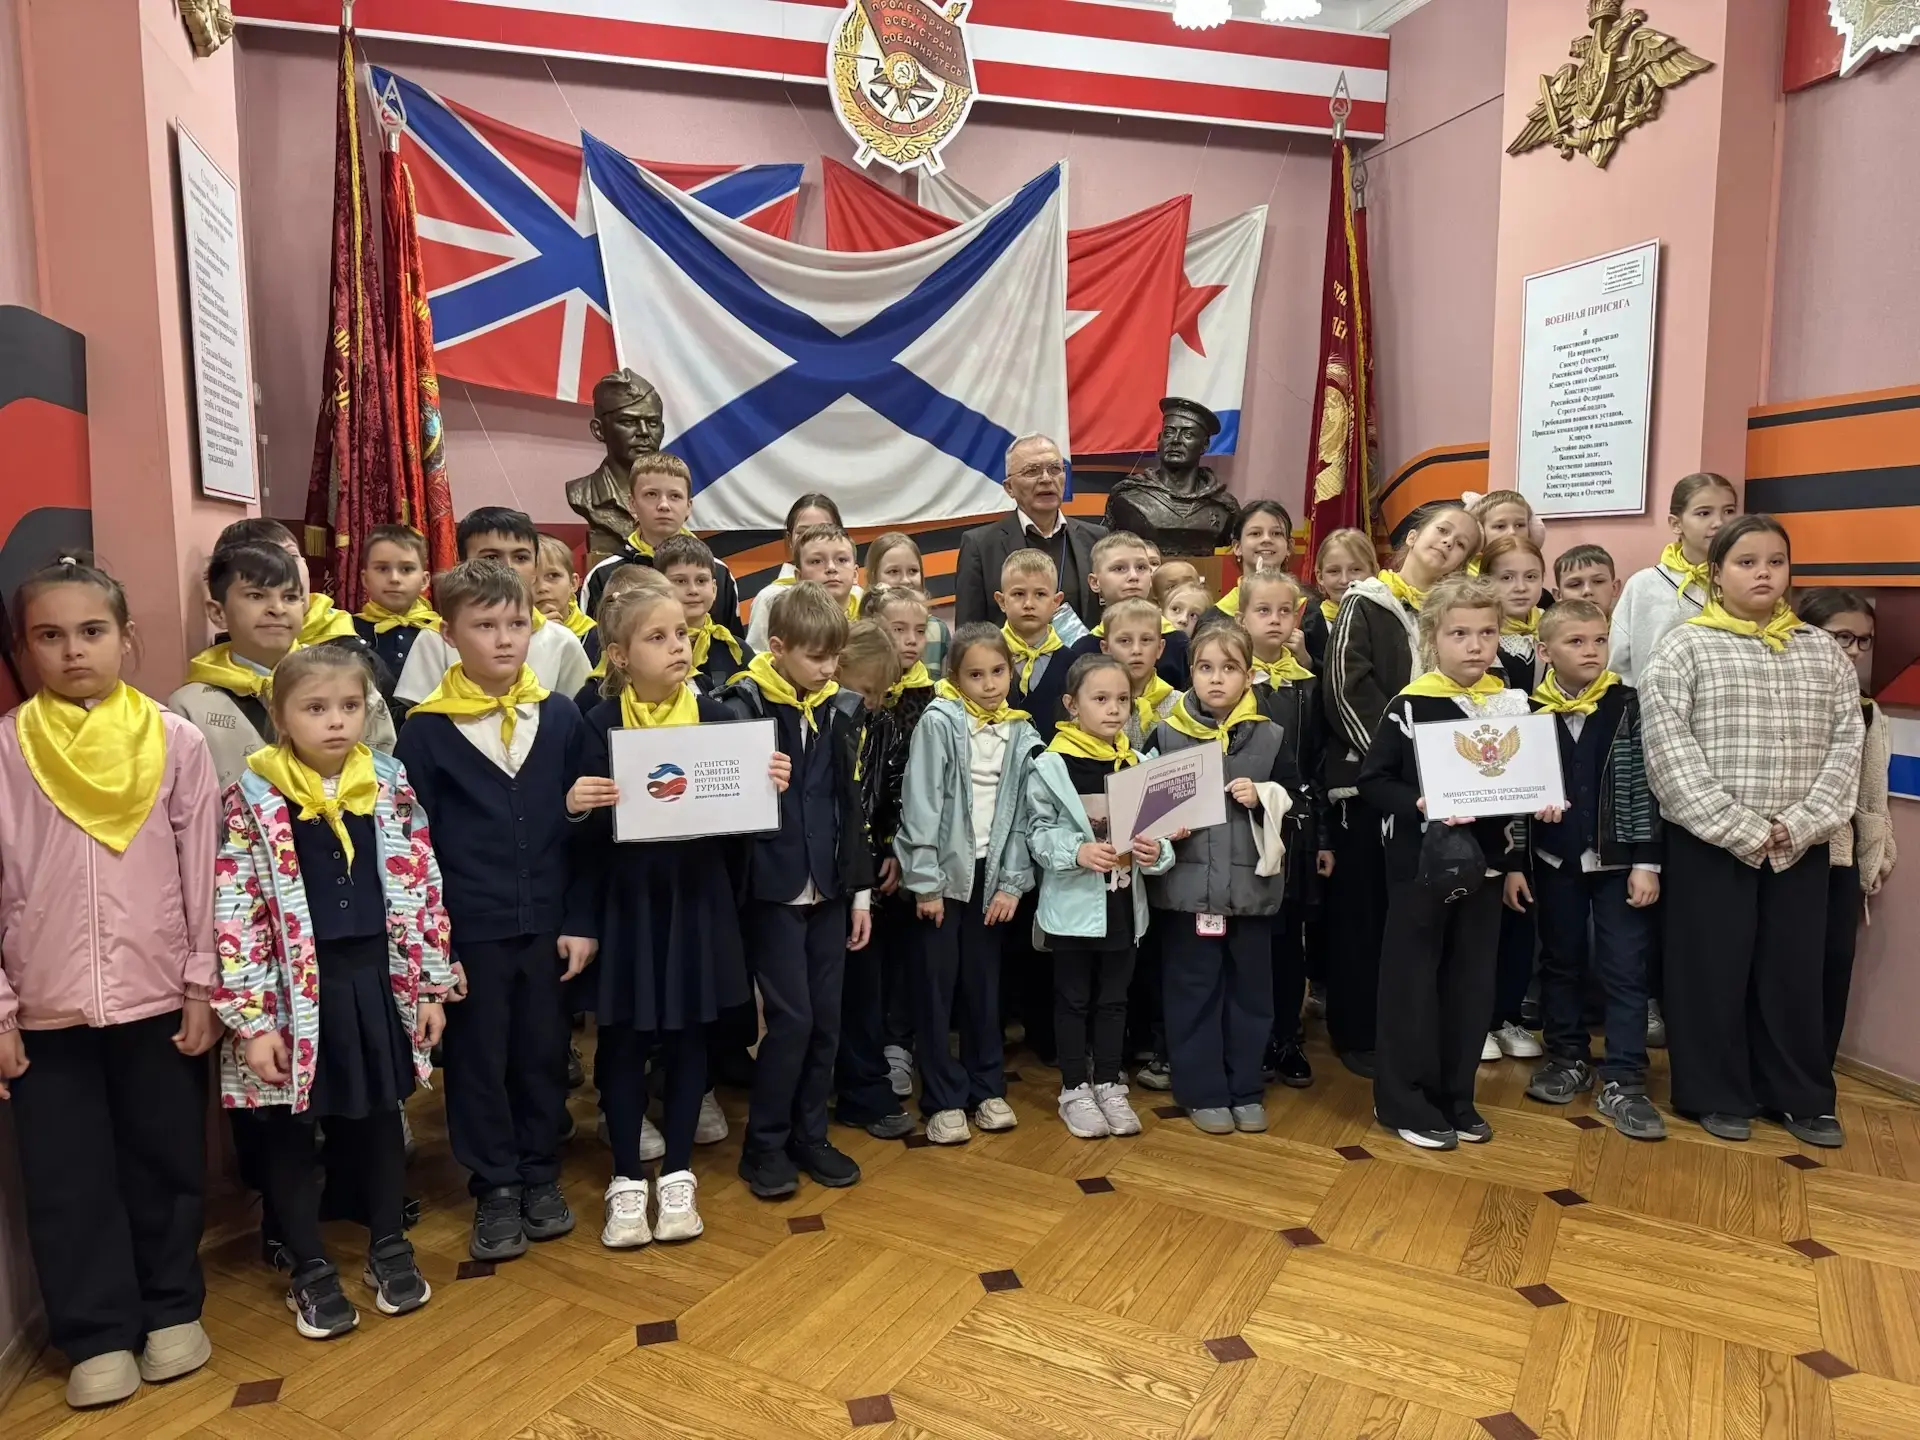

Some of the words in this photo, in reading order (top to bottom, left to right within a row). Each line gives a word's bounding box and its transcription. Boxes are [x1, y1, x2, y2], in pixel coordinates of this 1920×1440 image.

[872, 0, 952, 37] ПРОЛЕТАРИИ
[884, 16, 917, 30] ВСЕХ
[919, 27, 957, 59] СТРАН,
[882, 32, 966, 78] СОЕДИНЯЙТЕСЬ!
[1546, 309, 1586, 326] ВОЕННАЯ
[1588, 299, 1630, 316] ПРИСЯГА
[694, 760, 740, 769] АГЕНТСТВО
[694, 767, 740, 777] РАЗВИТИЯ
[694, 775, 740, 784] ВНУТРЕННЕГО
[1148, 773, 1195, 794] НАЦИОНАЛЬНЫЕ
[695, 782, 741, 792] ТУРИЗМА
[1167, 780, 1195, 795] ПРОЕКТЫ
[1172, 788, 1196, 800] РОССИИ
[1442, 788, 1497, 799] МИНИСТЕРСТВО
[1497, 785, 1546, 794] ПРОСВЕЩЕНИЯ
[1453, 795, 1498, 805] РОССИЙСКОЙ
[1499, 792, 1539, 801] ФЕДЕРАЦИИ
